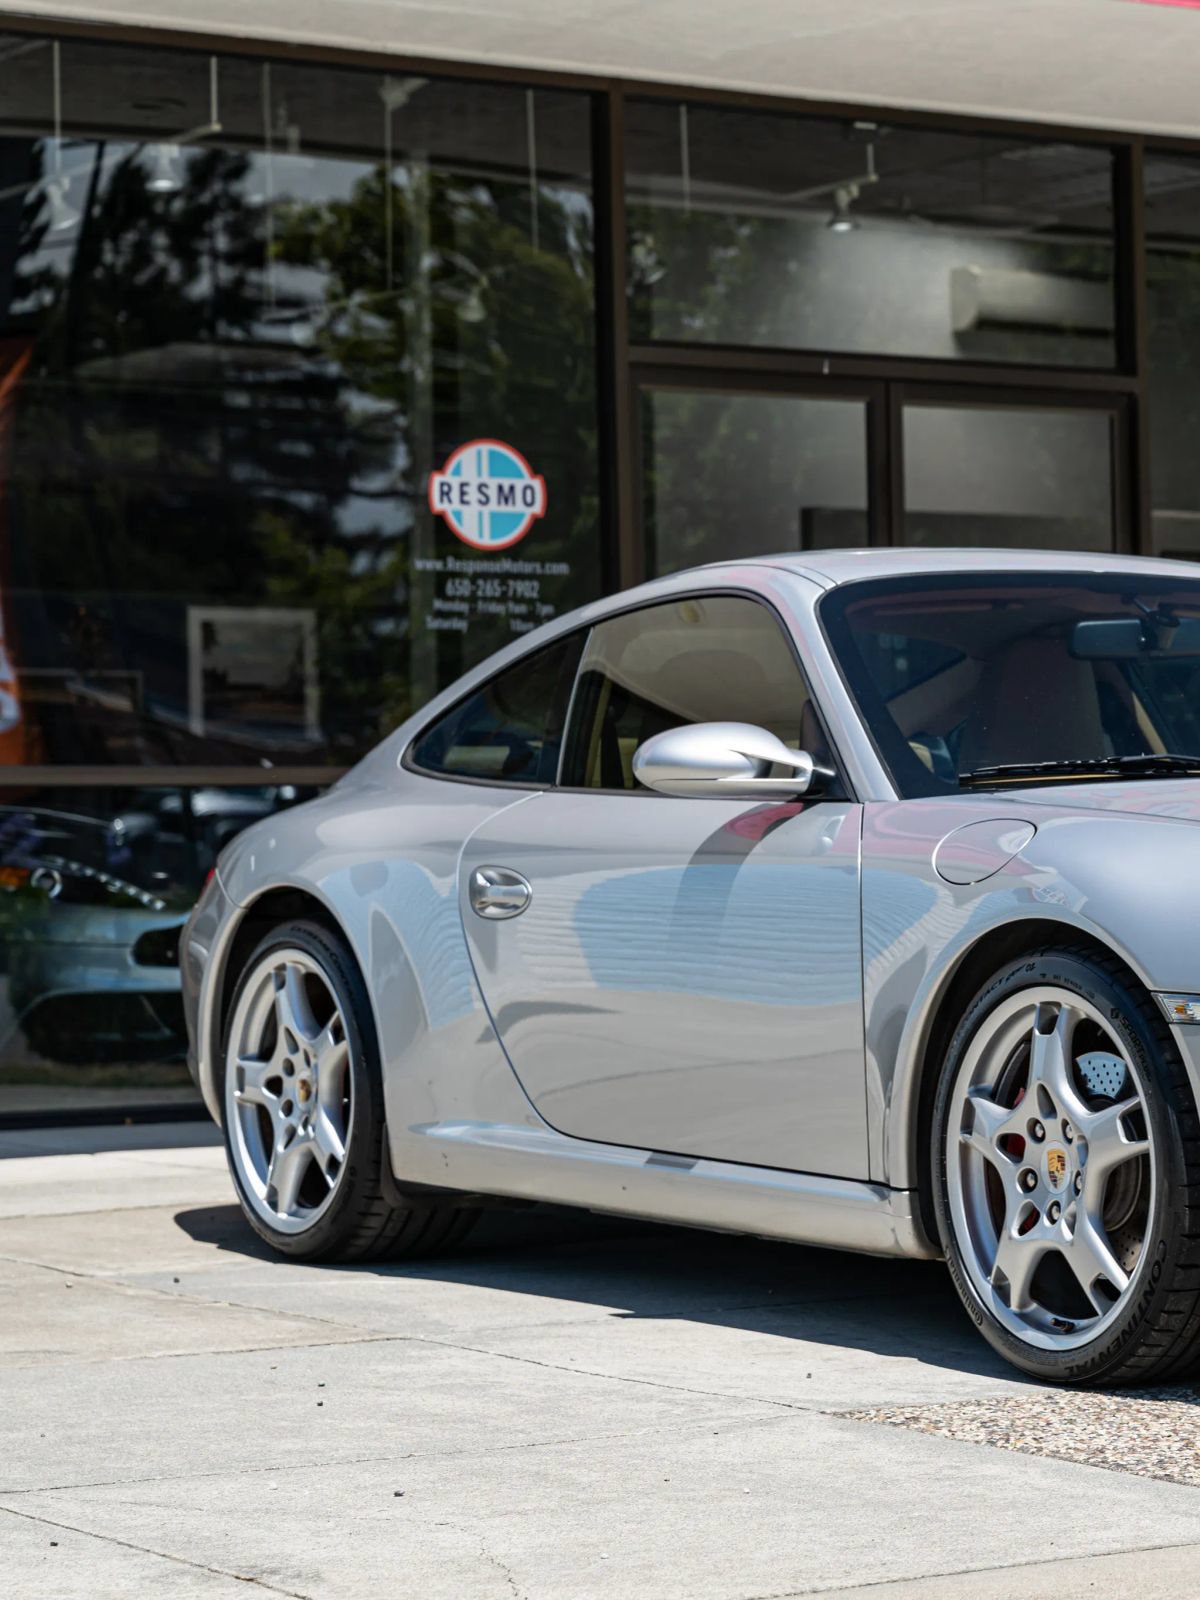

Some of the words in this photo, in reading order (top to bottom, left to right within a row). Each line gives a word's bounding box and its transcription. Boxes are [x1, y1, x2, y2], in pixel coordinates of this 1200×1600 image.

[439, 481, 536, 507] RESMO
[414, 555, 570, 576] www.ResponseMotors.com
[445, 577, 540, 598] 650-265-7902
[432, 598, 470, 615] Monday
[1064, 1239, 1167, 1377] CONTINENTAL
